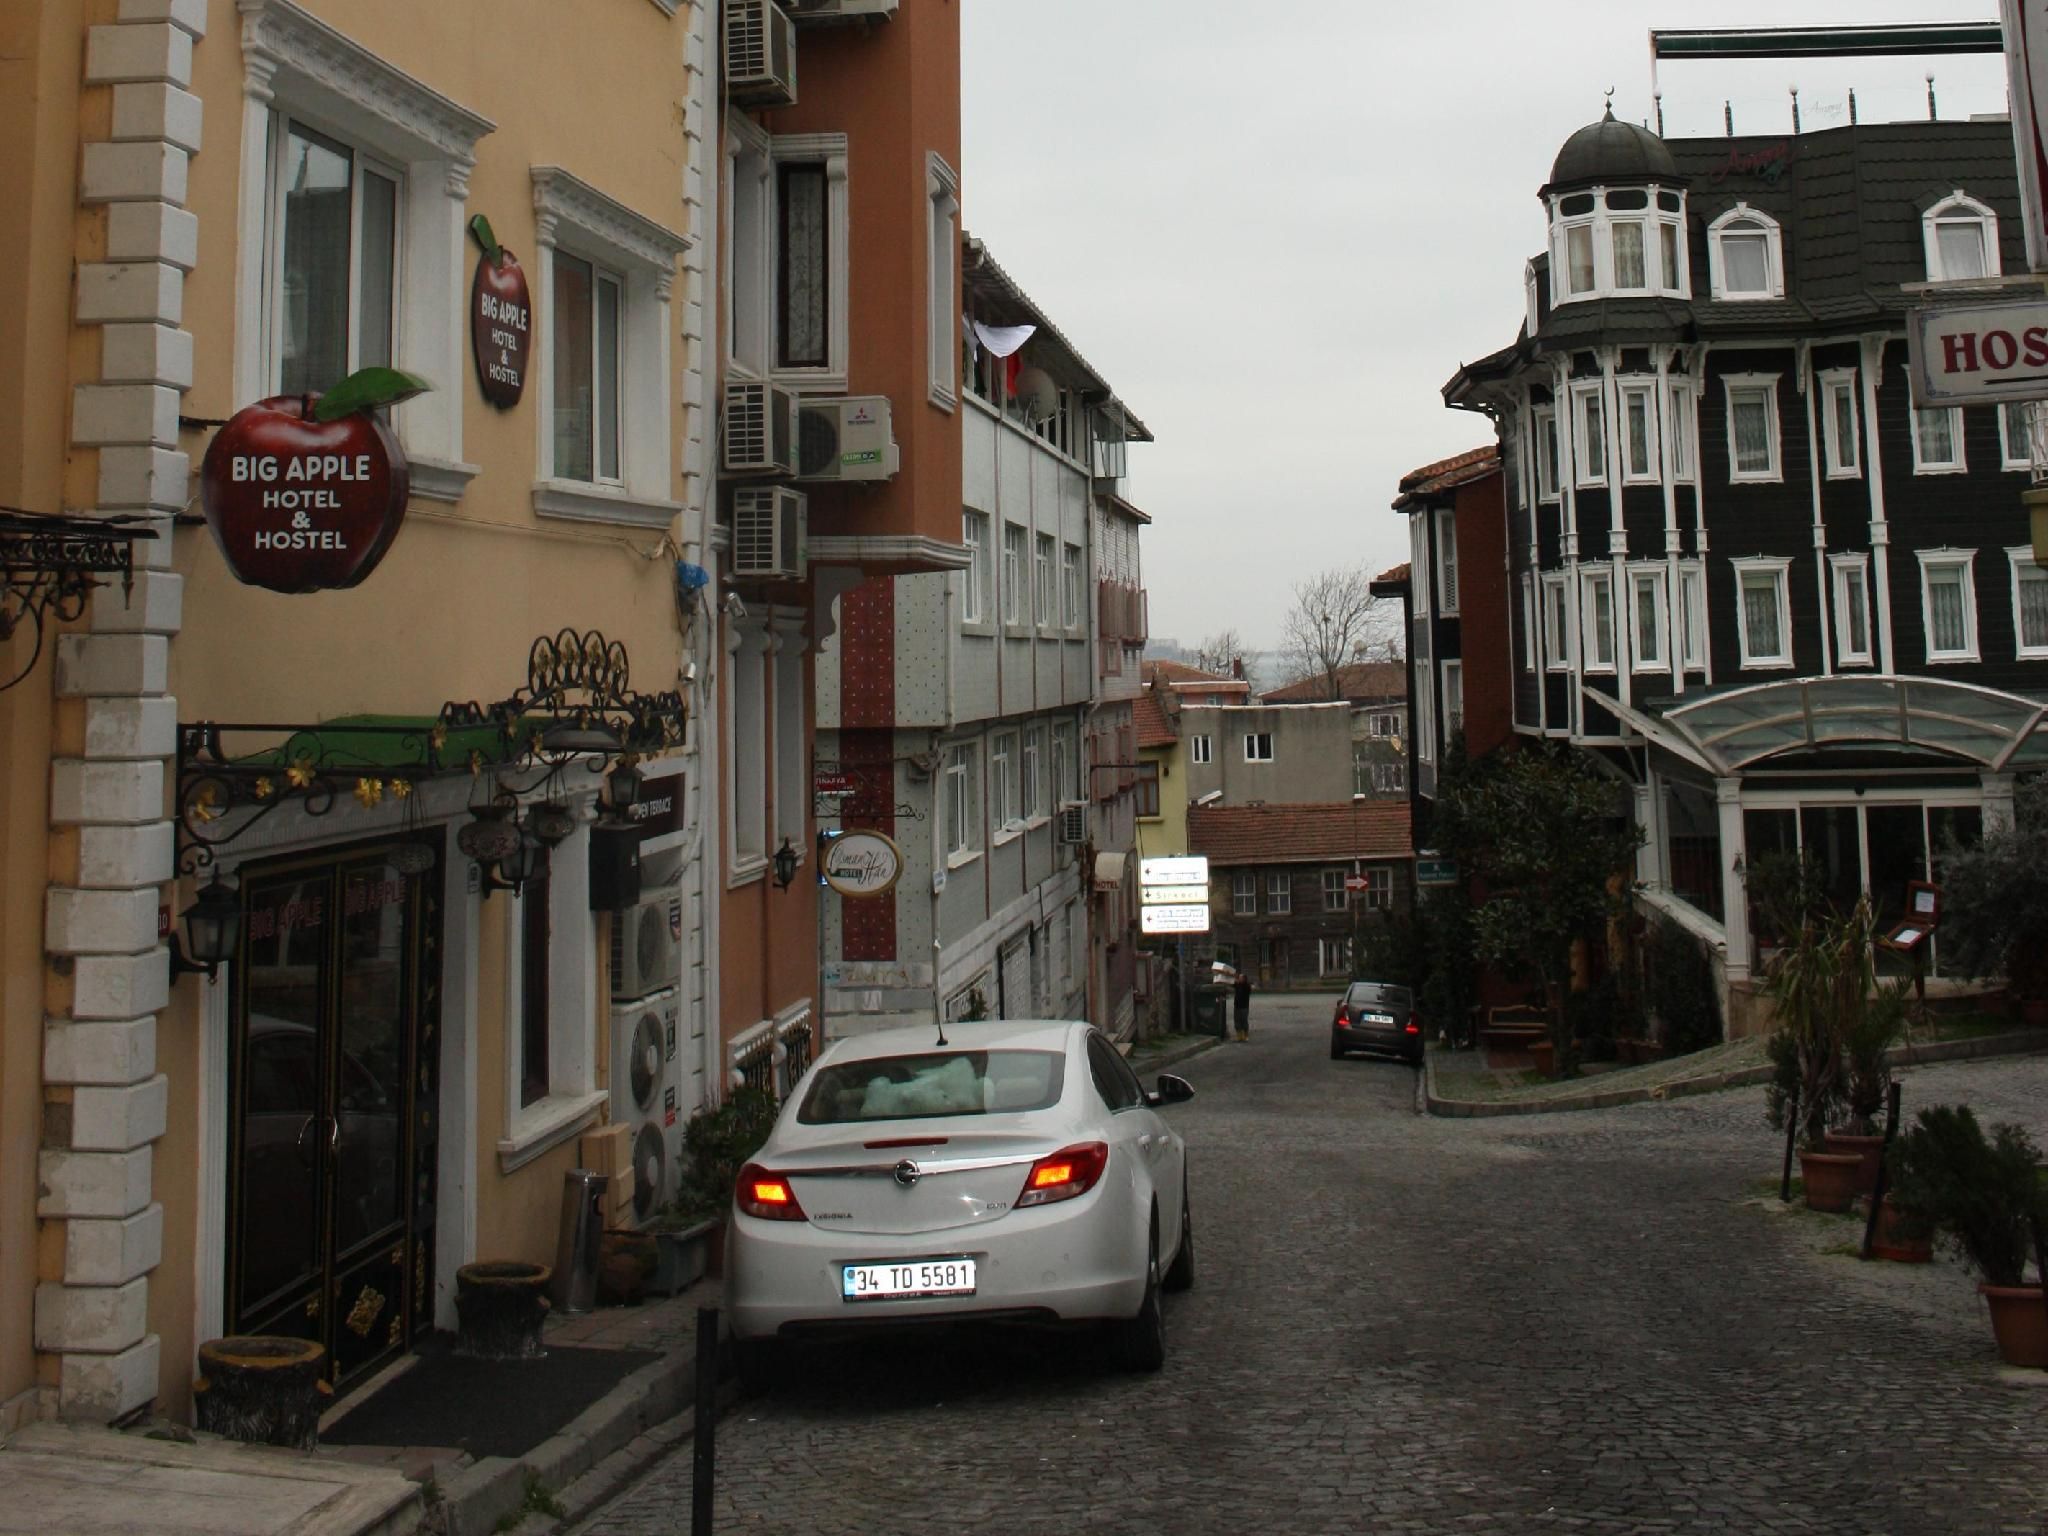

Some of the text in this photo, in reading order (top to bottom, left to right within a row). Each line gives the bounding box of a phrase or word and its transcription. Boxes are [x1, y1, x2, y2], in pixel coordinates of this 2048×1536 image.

[481, 293, 527, 331] BIG APPLE
[491, 328, 517, 351] HOTEL
[501, 349, 509, 365] &
[489, 363, 520, 387] HOSTEL
[232, 455, 370, 482] BIG APPLE
[263, 490, 342, 508] HOTEL
[291, 511, 311, 529] &
[255, 531, 347, 550] HOSTEL
[367, 876, 408, 910] APPLE
[1095, 881, 1120, 889] HOTEL
[248, 896, 322, 941] BIG APPLE
[857, 1264, 967, 1291] 34 TD 5581
